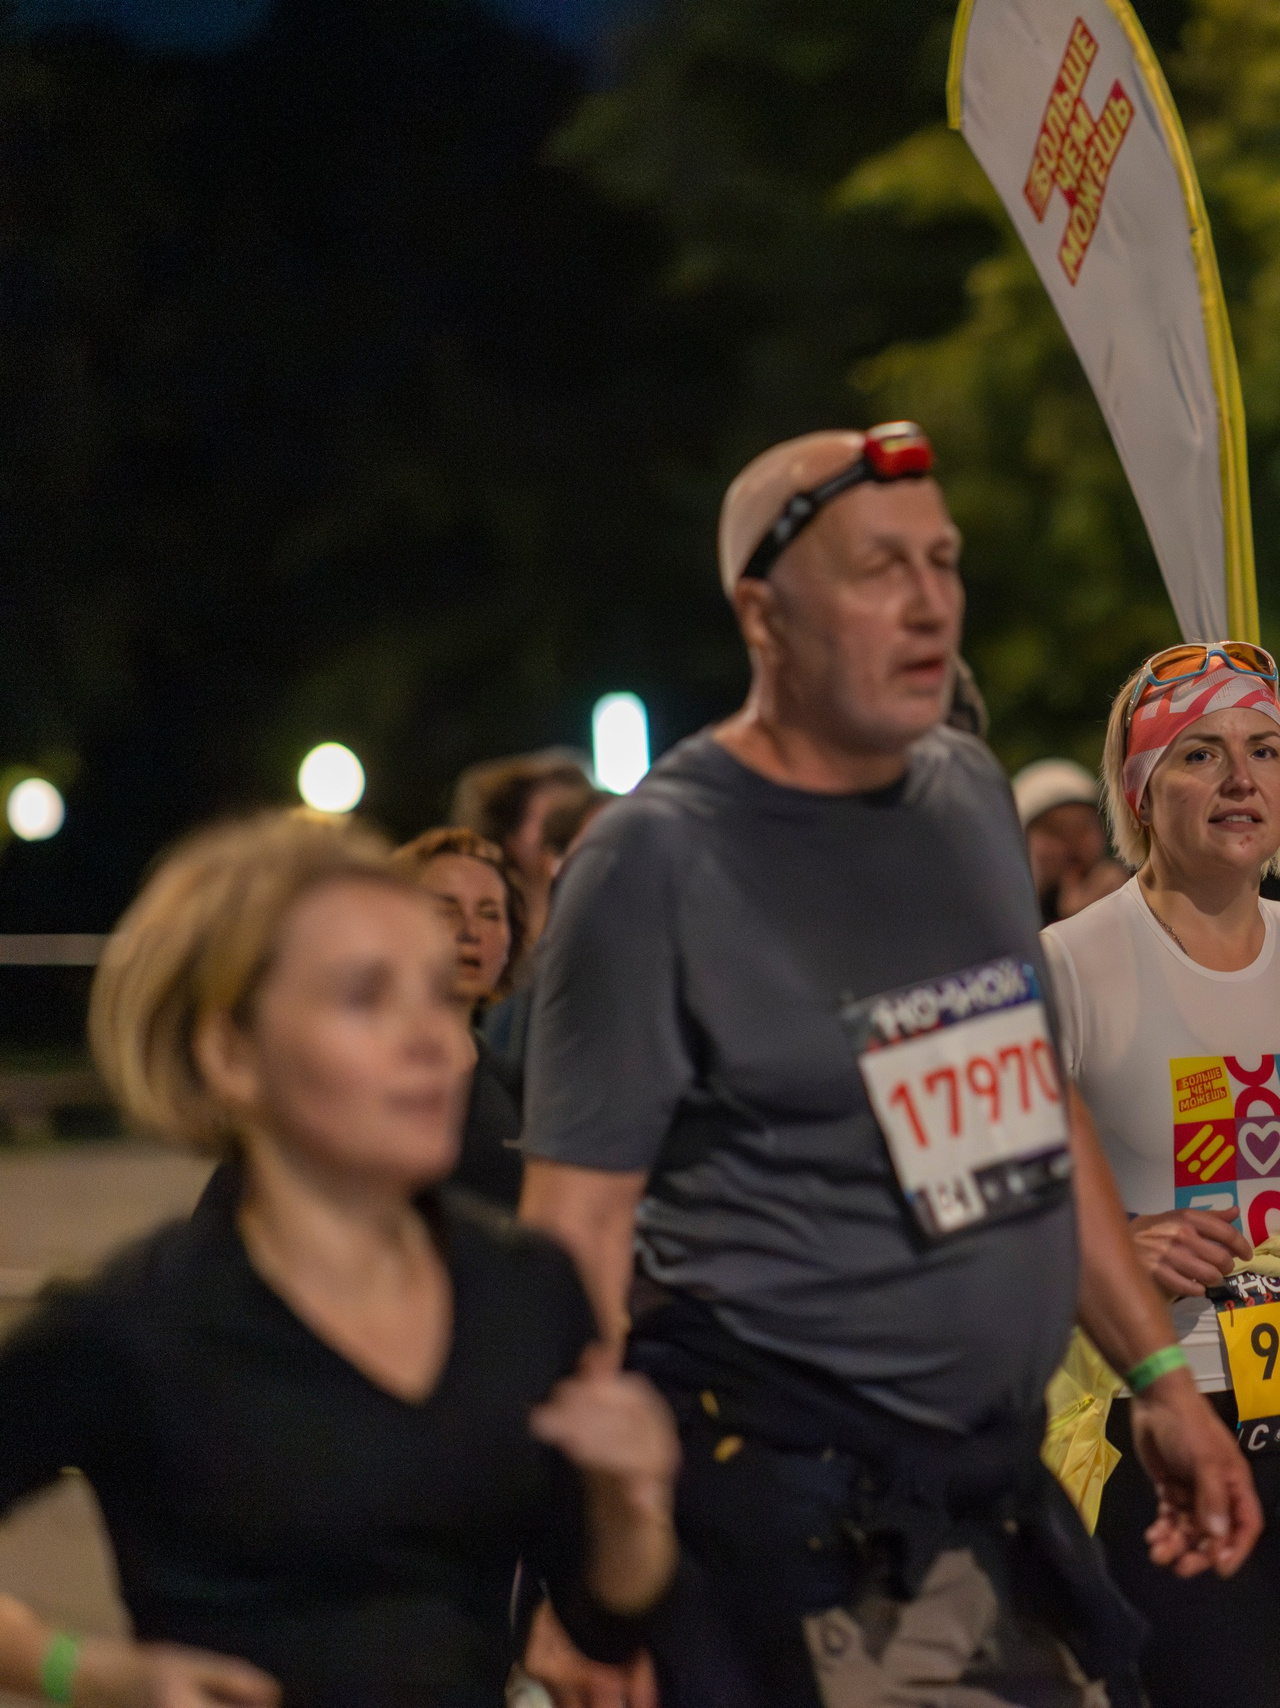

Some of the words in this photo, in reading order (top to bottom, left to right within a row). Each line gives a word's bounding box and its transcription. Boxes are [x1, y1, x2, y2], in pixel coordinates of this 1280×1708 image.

[1031, 23, 1097, 198] БОЛЬШЕ
[1056, 103, 1095, 191] ЧЕМ
[1060, 98, 1132, 284] МОЖЕШЬ
[1182, 1068, 1222, 1089] БОЛЬШЕ
[1191, 1081, 1213, 1096] ЧЕМ
[1180, 1089, 1226, 1111] МОЖЕШЬ
[1247, 1423, 1270, 1452] C
